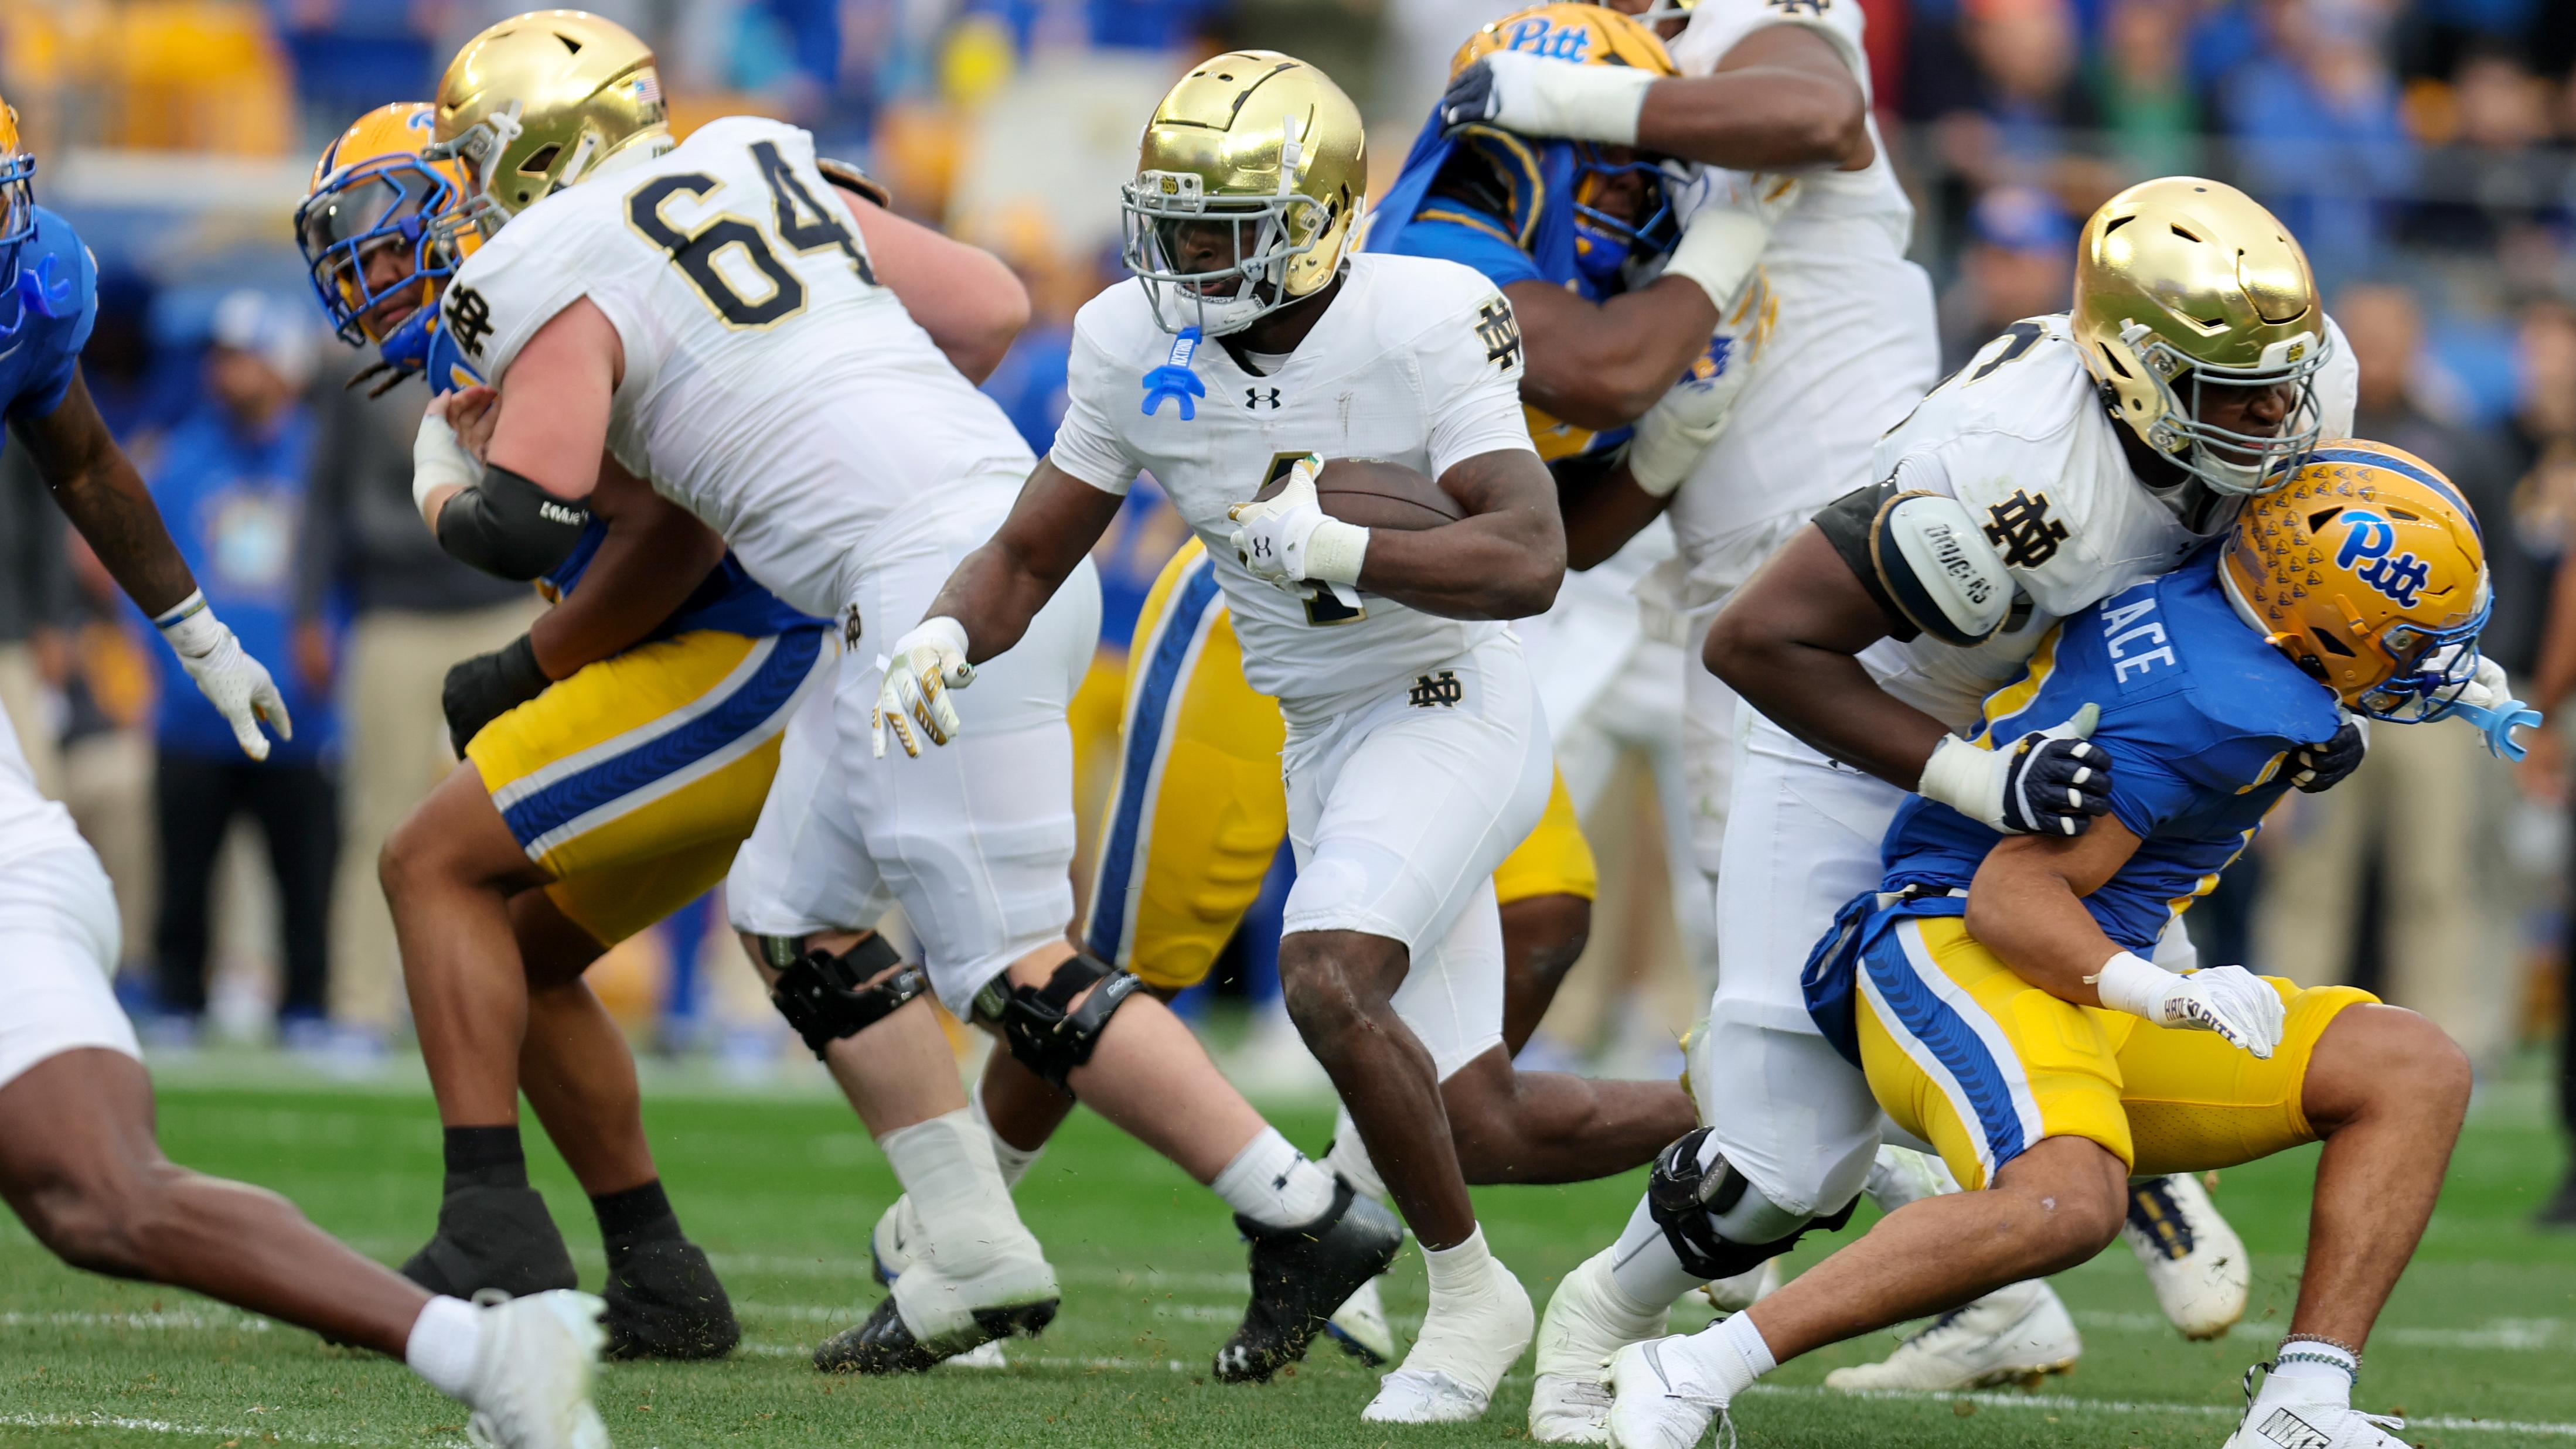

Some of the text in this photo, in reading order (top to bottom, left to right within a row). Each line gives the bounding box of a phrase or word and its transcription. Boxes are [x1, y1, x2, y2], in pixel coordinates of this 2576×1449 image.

[1503, 17, 1590, 64] Pitt
[623, 138, 882, 332] 64
[1982, 487, 2072, 571] ND
[2335, 509, 2430, 609] Pitt
[2100, 596, 2176, 684] ACE
[1408, 670, 1463, 708] ND
